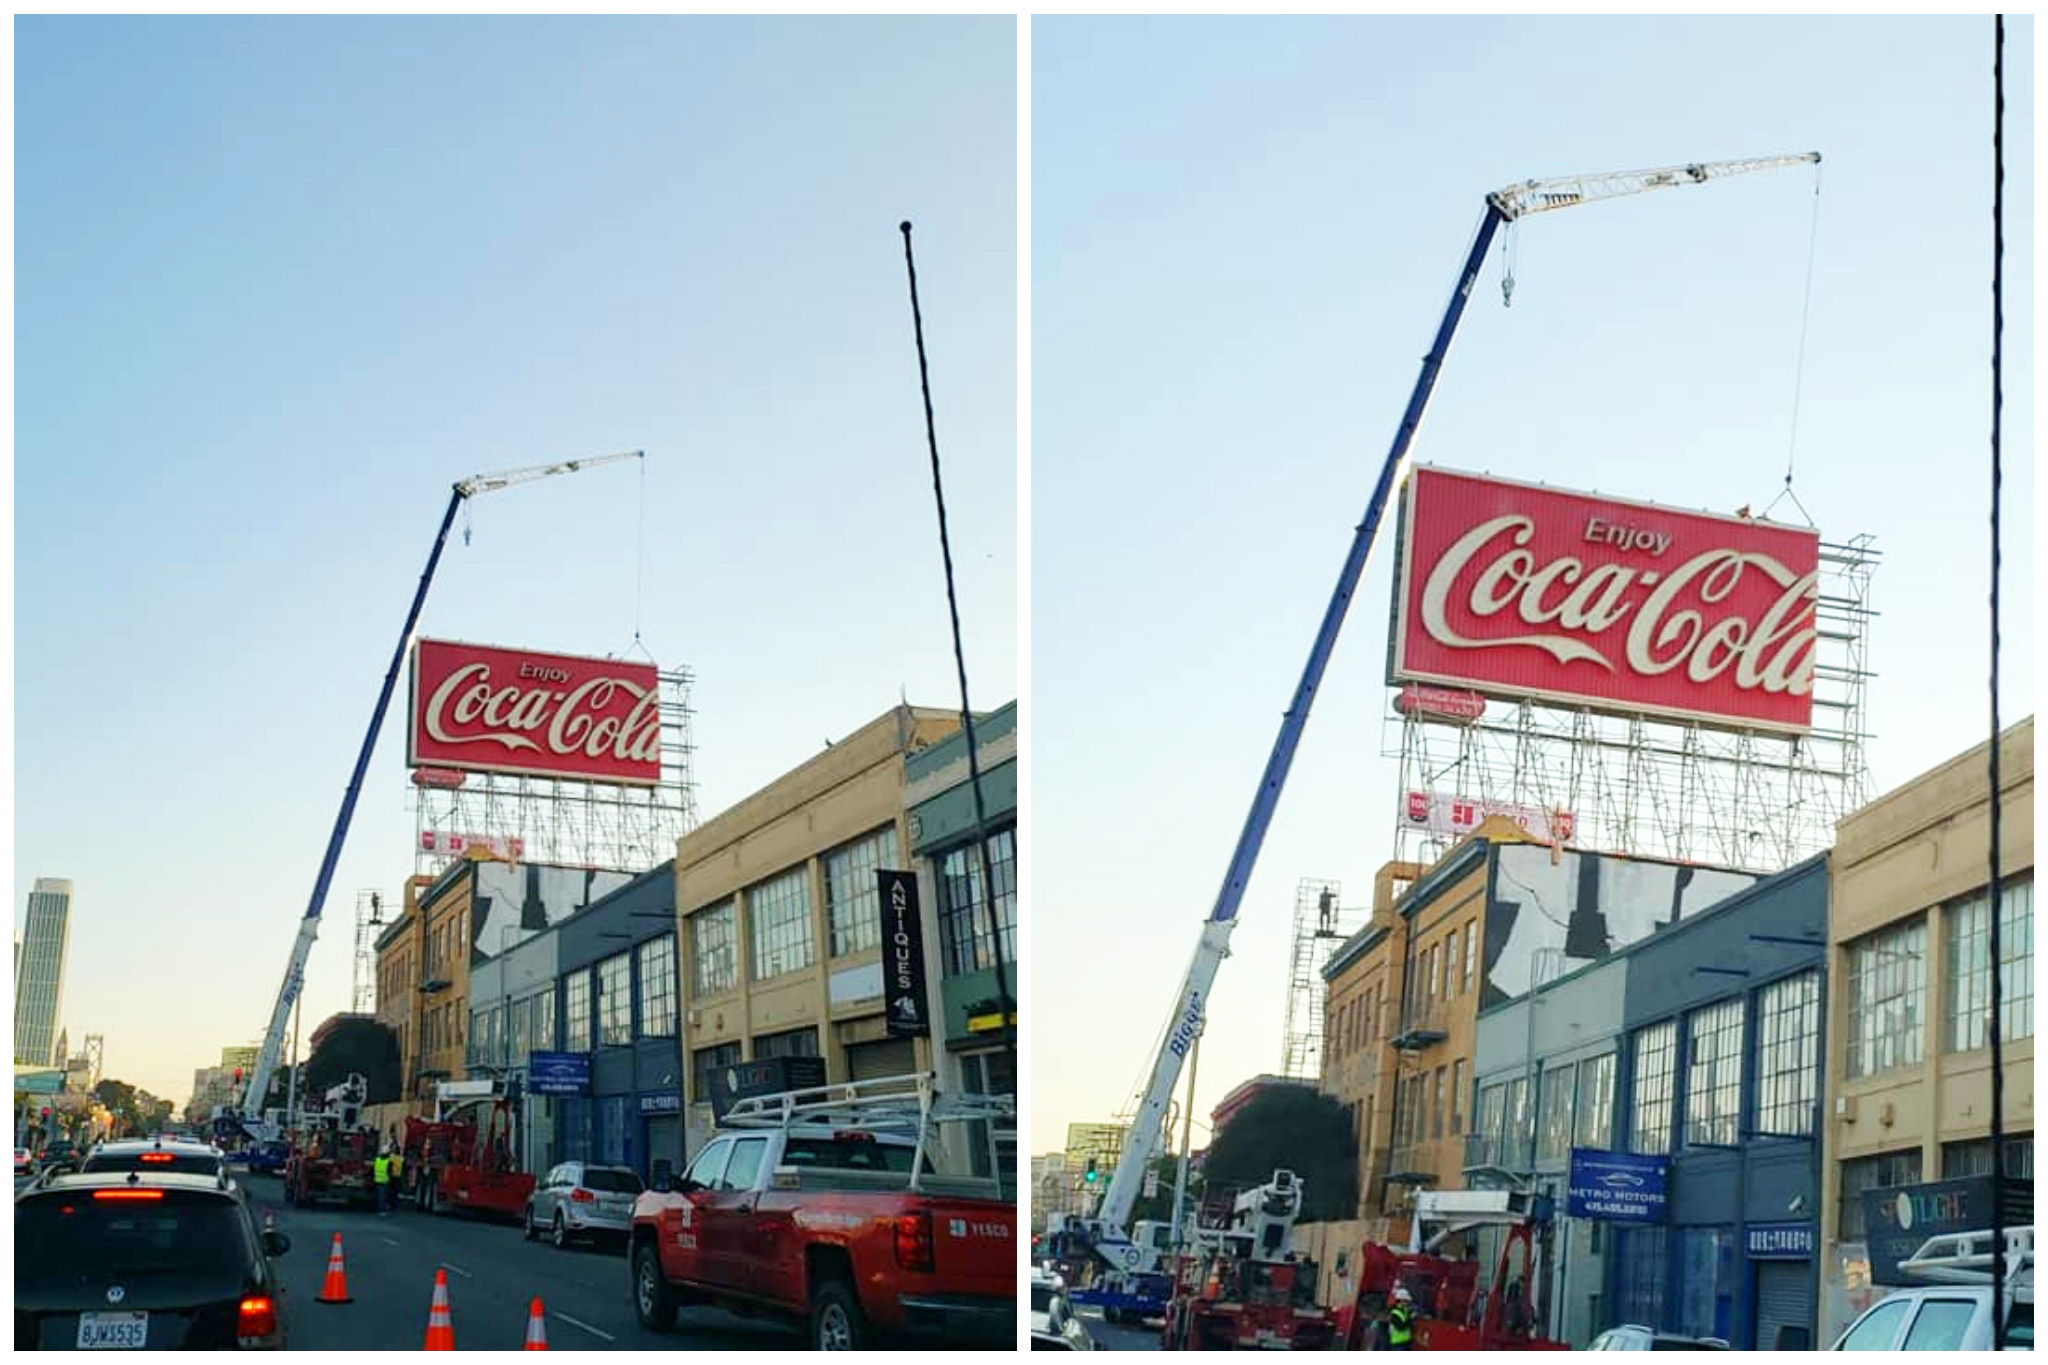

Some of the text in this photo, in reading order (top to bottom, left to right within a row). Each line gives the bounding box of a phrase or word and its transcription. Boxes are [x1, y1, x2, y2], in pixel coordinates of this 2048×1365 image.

[1583, 517, 1672, 555] Enjoy
[1420, 514, 1819, 696] Coca-Cola
[519, 661, 573, 684] Enjoy
[425, 662, 660, 763] Coca-Cola
[890, 878, 911, 990] ANTIQUES
[1568, 1187, 1666, 1203] METRO MOTORS
